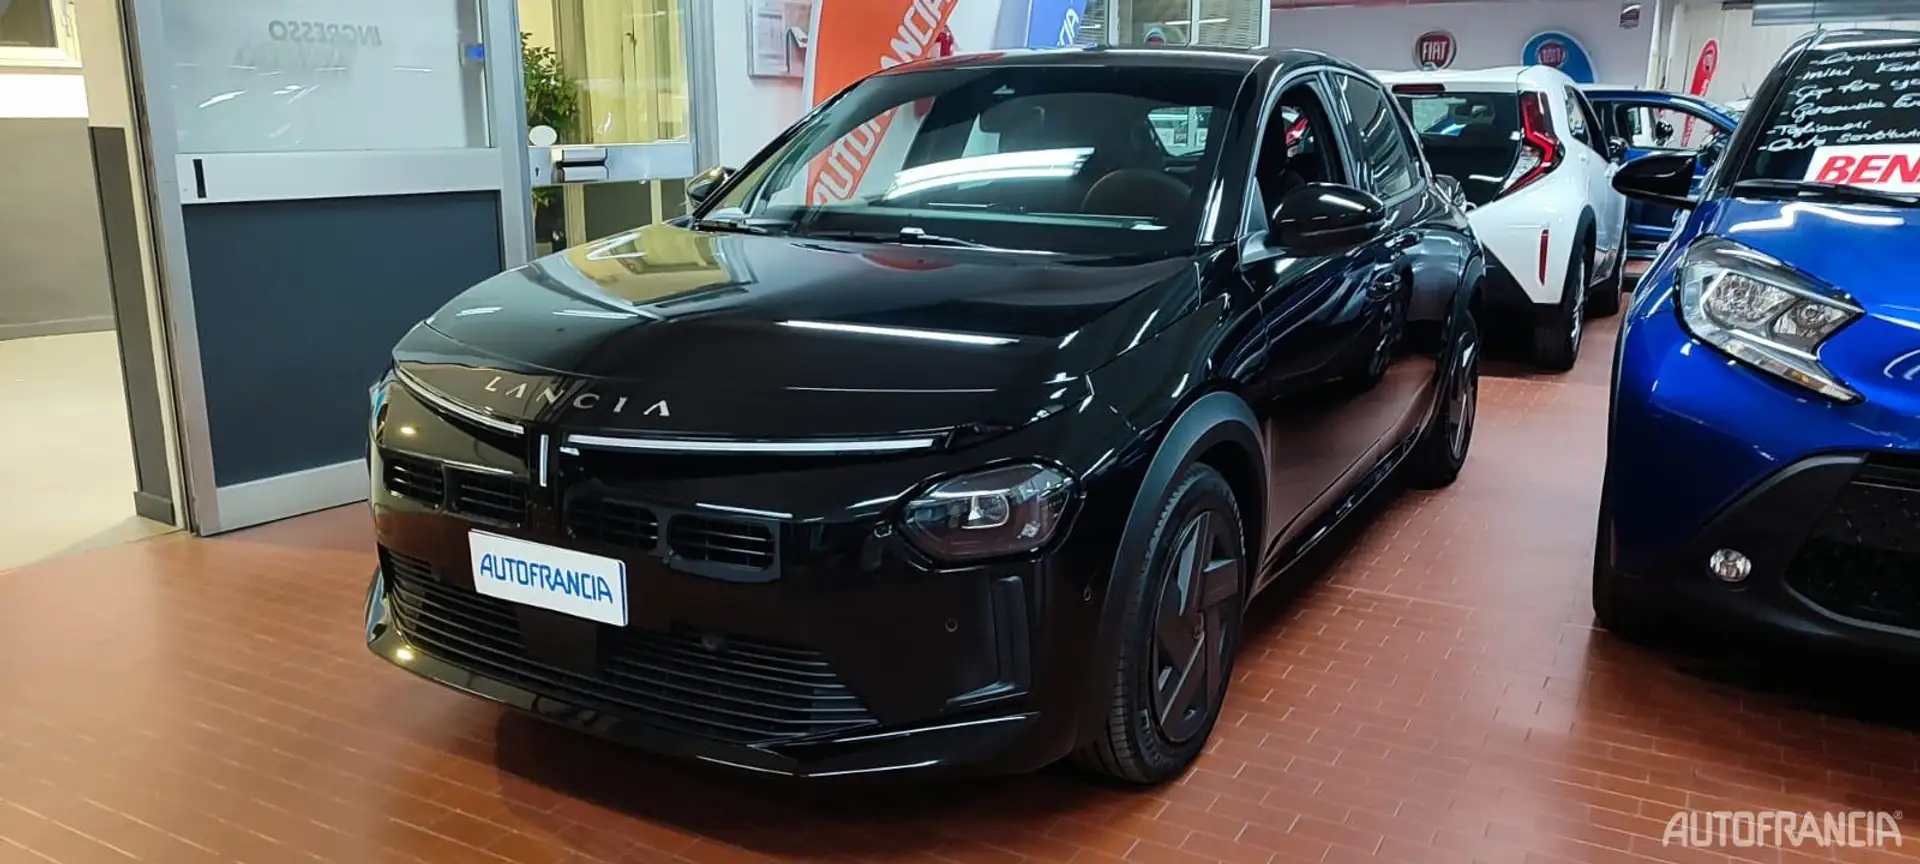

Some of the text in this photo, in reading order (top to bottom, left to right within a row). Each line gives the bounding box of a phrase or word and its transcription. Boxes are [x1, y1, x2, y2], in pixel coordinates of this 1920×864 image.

[1422, 40, 1447, 61] FIAT
[1815, 155, 1920, 184] BEN
[485, 376, 670, 417] LANCIA
[480, 553, 613, 604] AUTOFRANCIA
